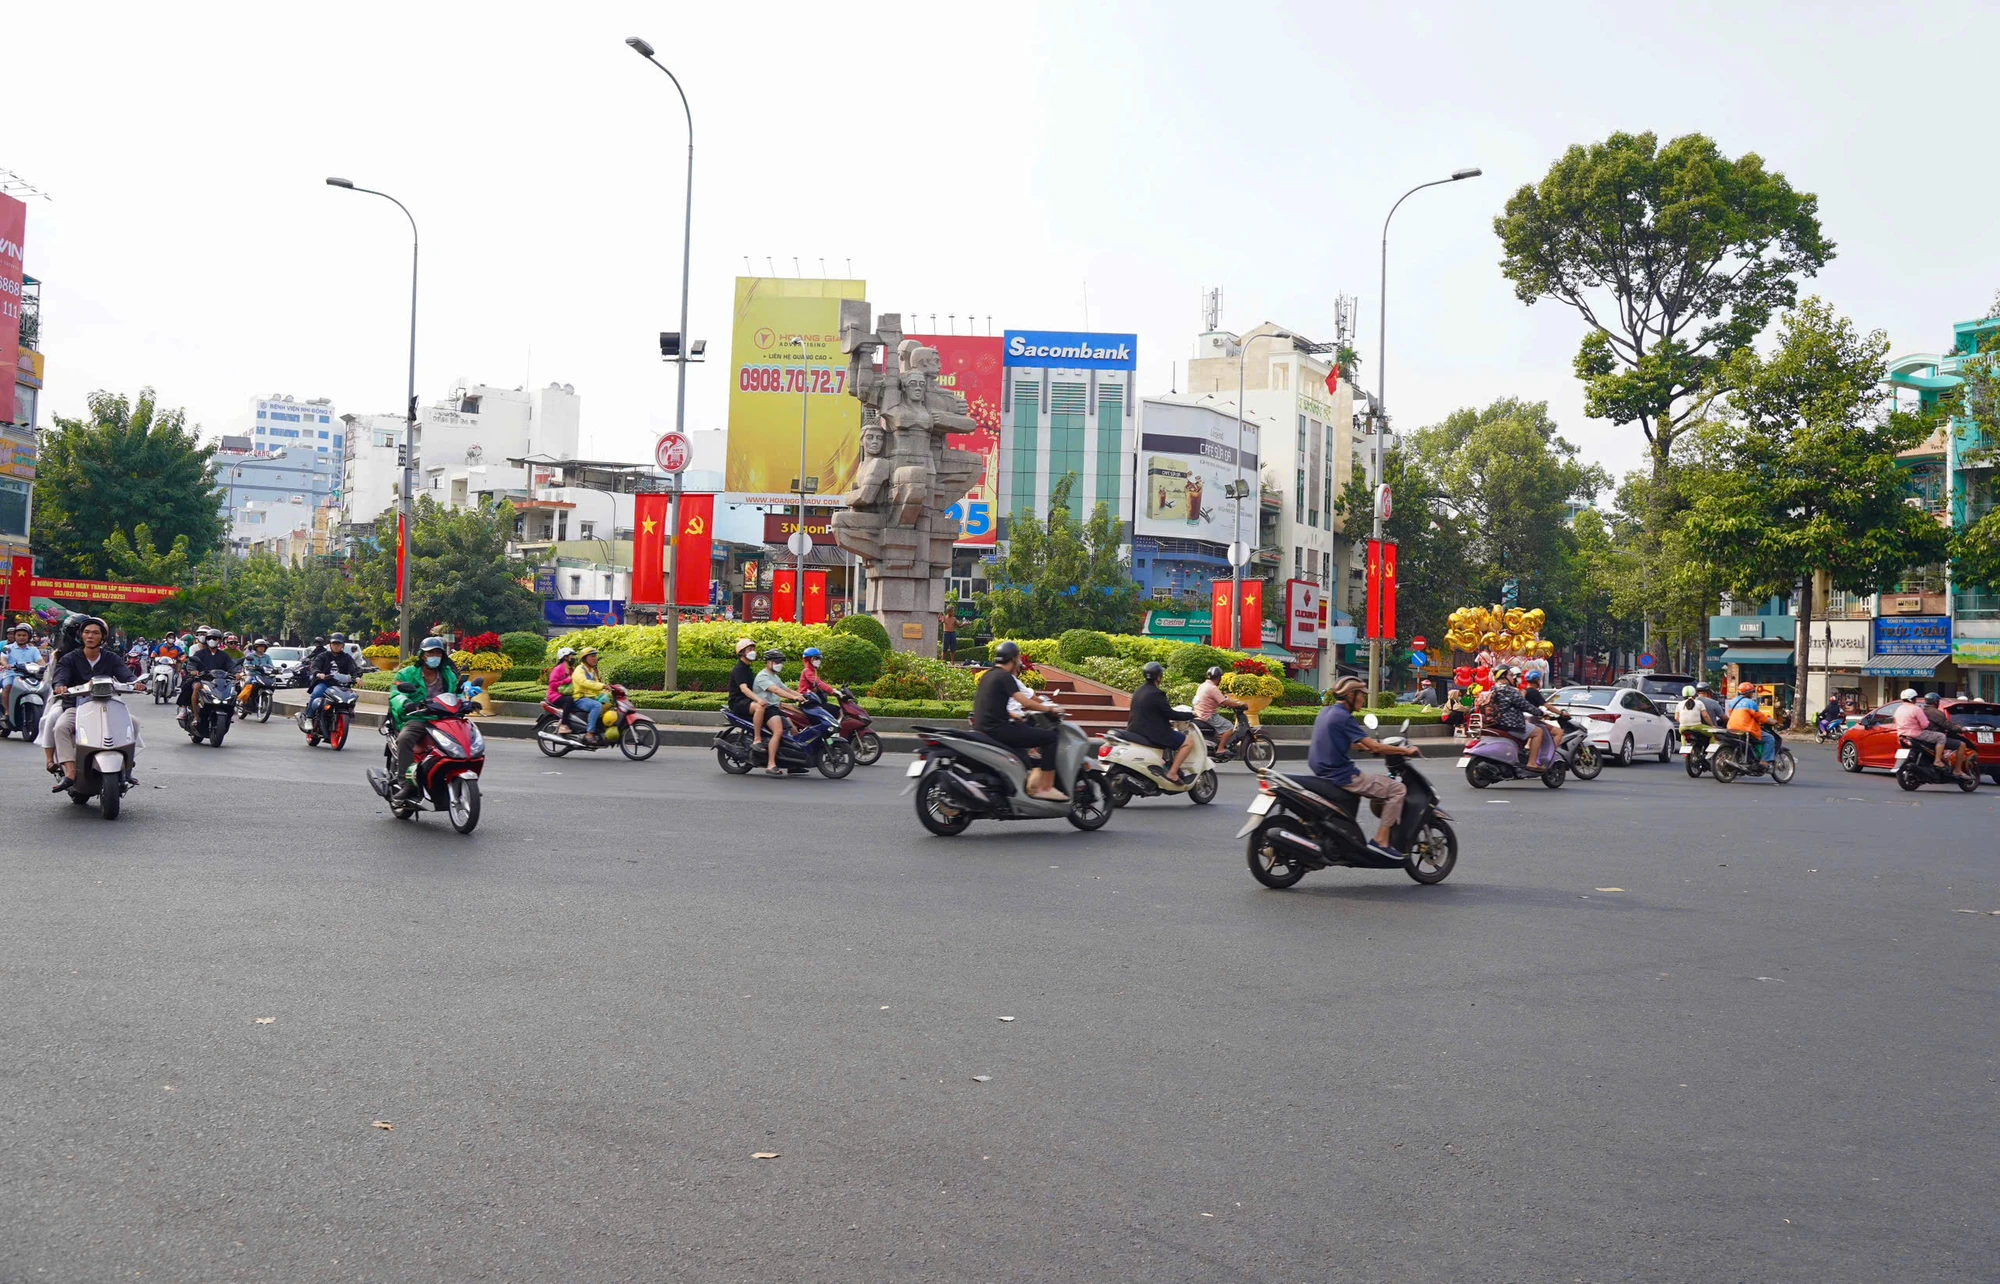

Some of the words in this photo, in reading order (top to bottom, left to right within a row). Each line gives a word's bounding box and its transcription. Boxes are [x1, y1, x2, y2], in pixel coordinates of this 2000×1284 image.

[1008, 336, 1130, 360] Sacombank
[287, 404, 300, 412] VIỆN
[746, 497, 840, 505] WWW.HOANGGADV.COM
[1880, 625, 1910, 637] TRÚC
[1914, 625, 1948, 637] CHÂU
